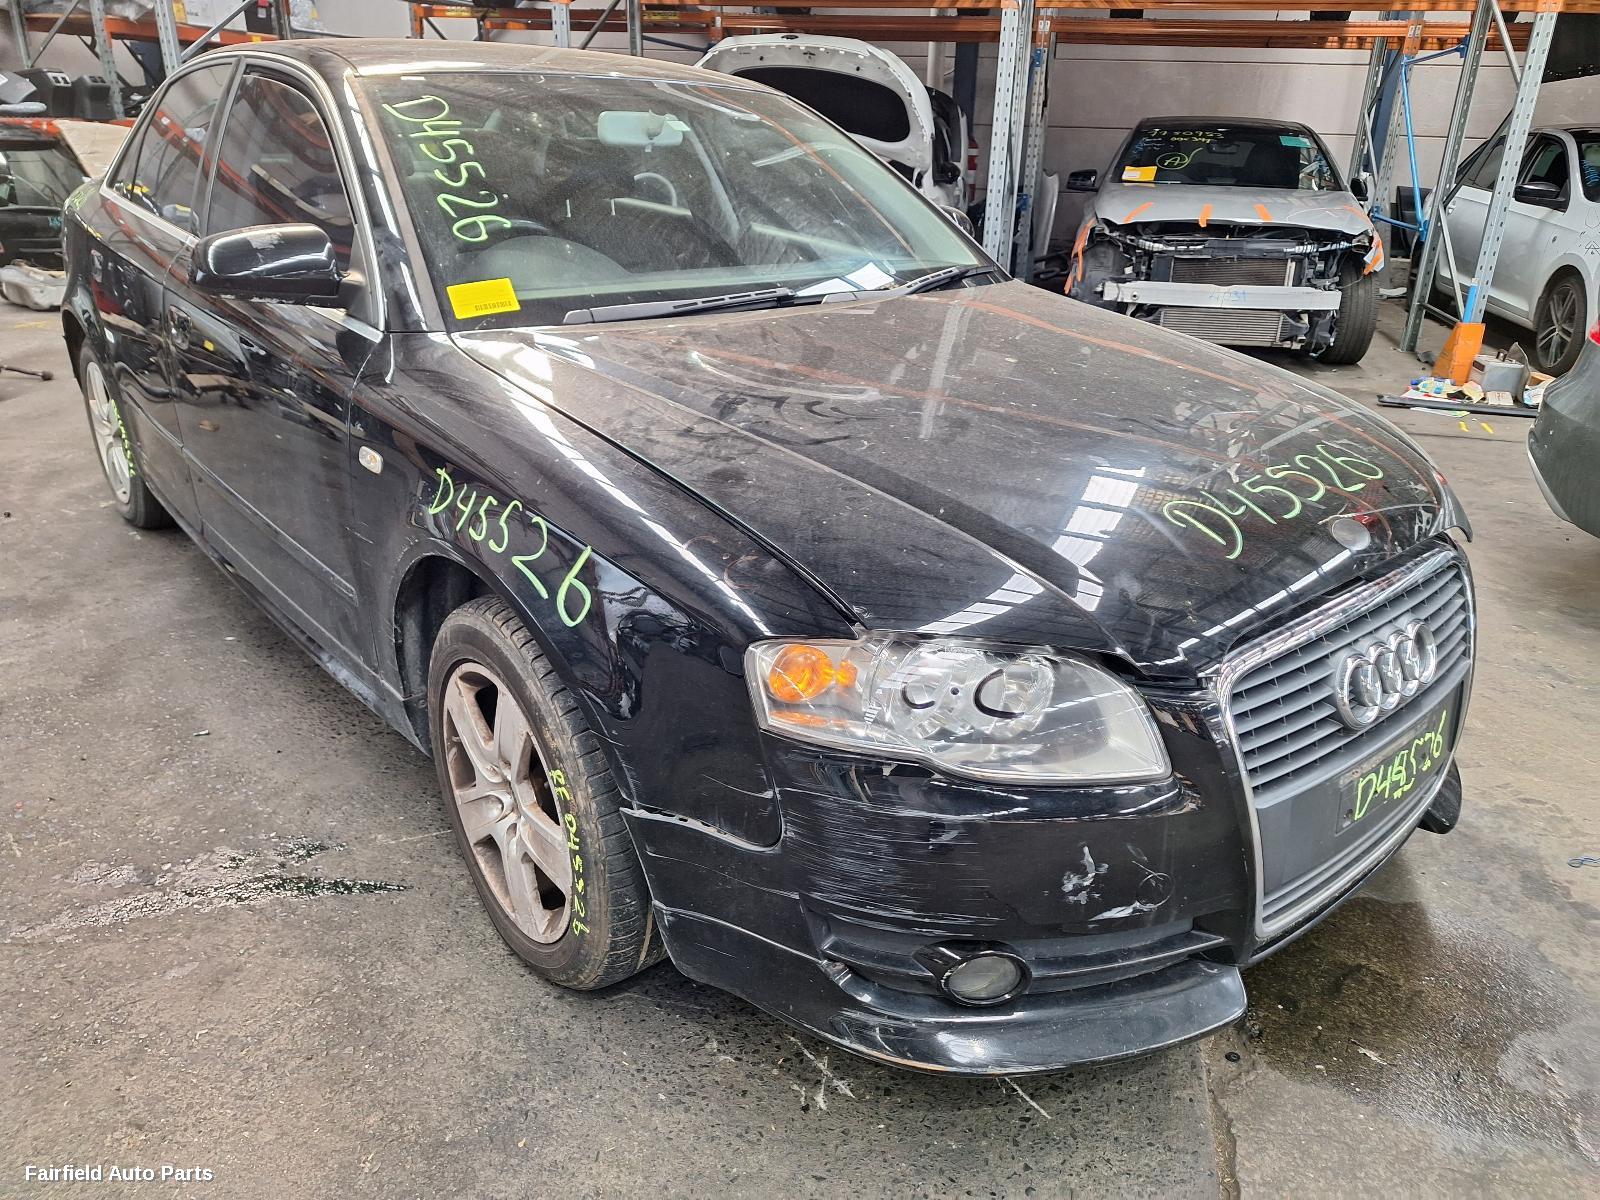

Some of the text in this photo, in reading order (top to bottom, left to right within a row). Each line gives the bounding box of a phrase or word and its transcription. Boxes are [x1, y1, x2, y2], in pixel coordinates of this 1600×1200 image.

[382, 95, 512, 242] D45526
[428, 467, 592, 628] D45526
[1162, 444, 1384, 560] D45526
